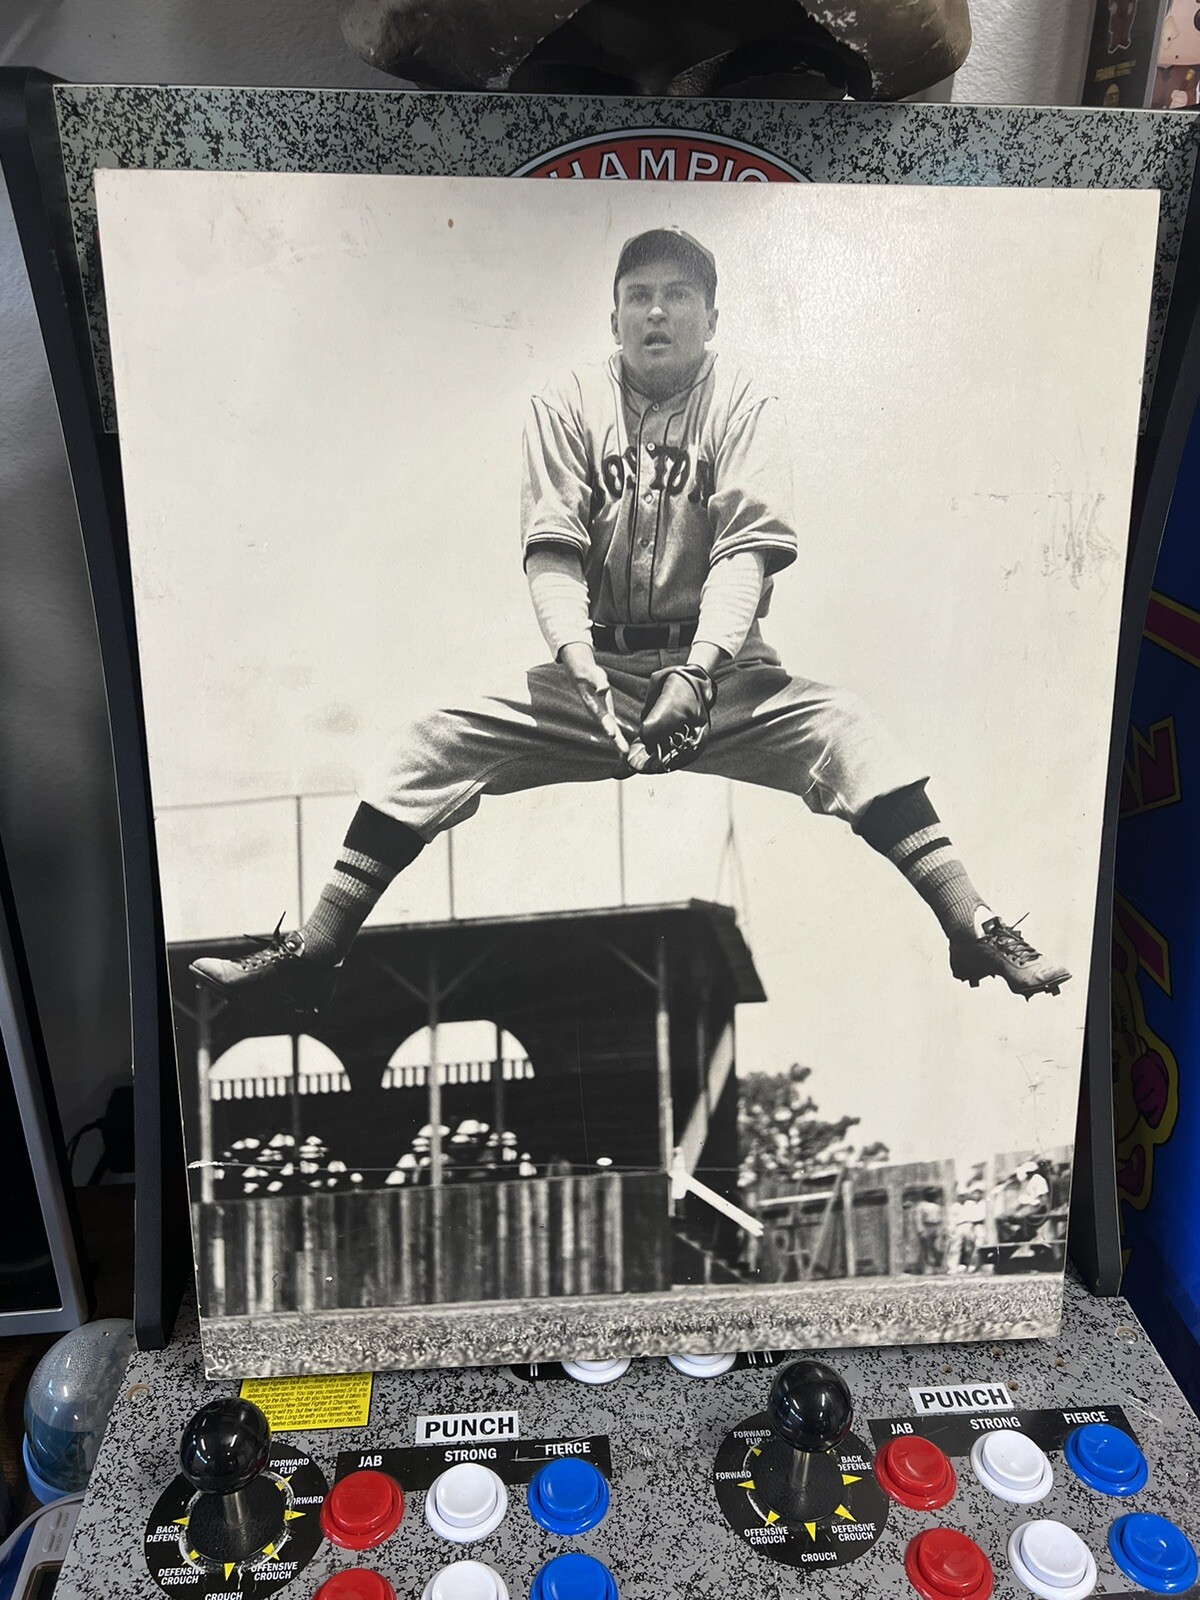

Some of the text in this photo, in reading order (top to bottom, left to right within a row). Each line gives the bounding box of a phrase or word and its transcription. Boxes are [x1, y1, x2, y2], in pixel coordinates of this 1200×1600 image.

[919, 1388, 1008, 1409] PUNCH
[424, 1416, 515, 1439] PUNCH
[890, 1411, 1110, 1436] JAB STRONG FIERCE
[733, 1429, 772, 1439] FORWARD
[745, 1437, 763, 1446] FLIP
[357, 1441, 592, 1469] JAB STRONG FIERCE
[840, 1455, 864, 1464] BACK
[269, 1458, 310, 1468] FORWARD
[279, 1466, 298, 1475] FLIP
[715, 1470, 753, 1480] FORWARD
[155, 1525, 180, 1534] BACK
[743, 1526, 790, 1538] OFFENSIVE
[830, 1523, 877, 1534] DEFENSIVE
[750, 1535, 787, 1546] CROUCH
[837, 1532, 875, 1542] CROUCH
[800, 1552, 838, 1563] CROUCH
[160, 1575, 200, 1586] CROUCH
[253, 1570, 293, 1581] CROUCH
[204, 1591, 244, 1600] CROUCH
